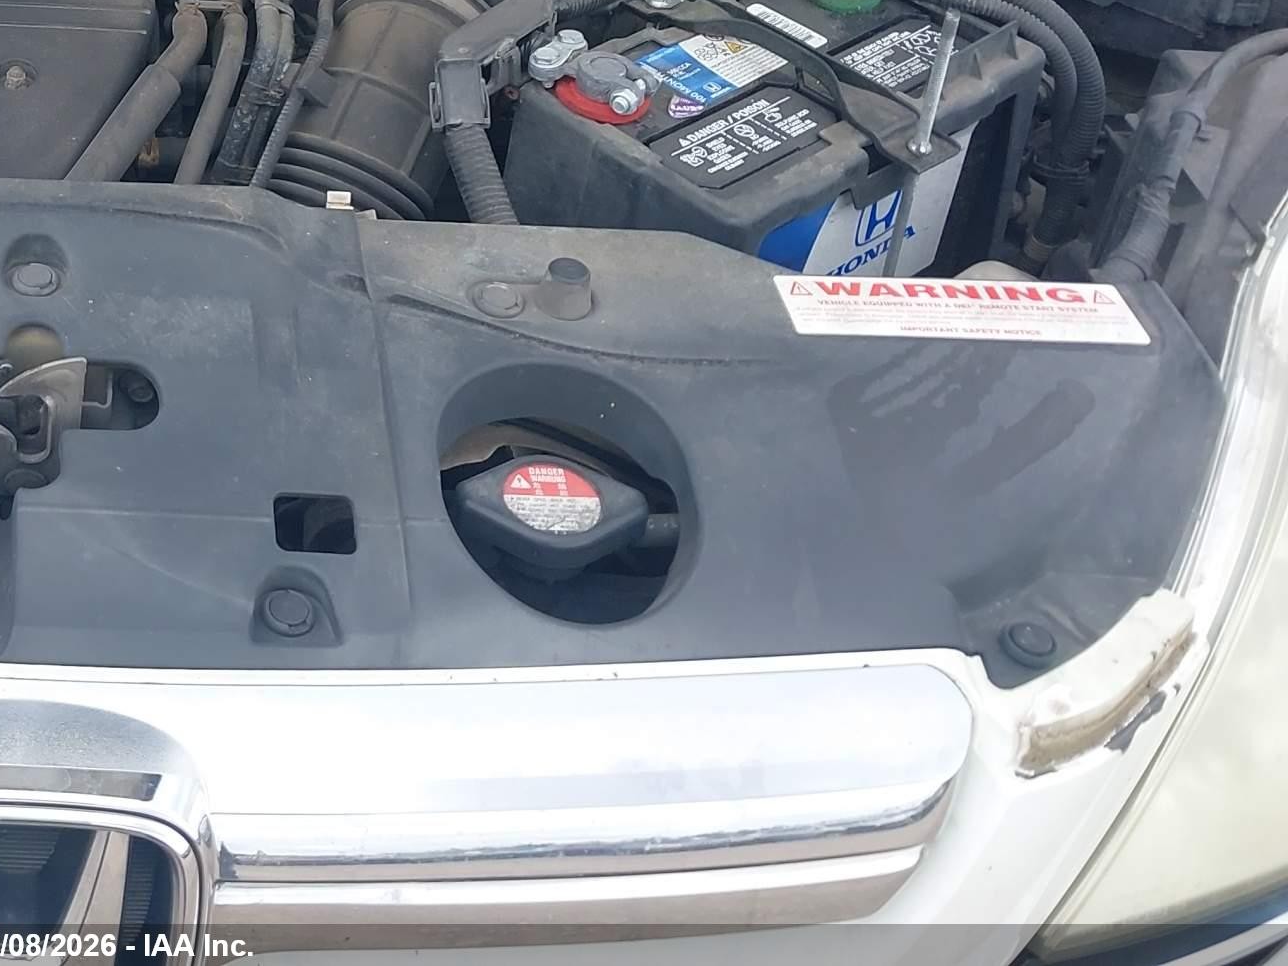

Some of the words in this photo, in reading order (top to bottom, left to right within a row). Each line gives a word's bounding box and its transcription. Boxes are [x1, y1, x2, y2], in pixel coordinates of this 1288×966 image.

[687, 119, 728, 142] DANGER
[734, 98, 772, 121] POISON
[814, 281, 1087, 304] WARNING
[528, 467, 565, 476] DANGER
